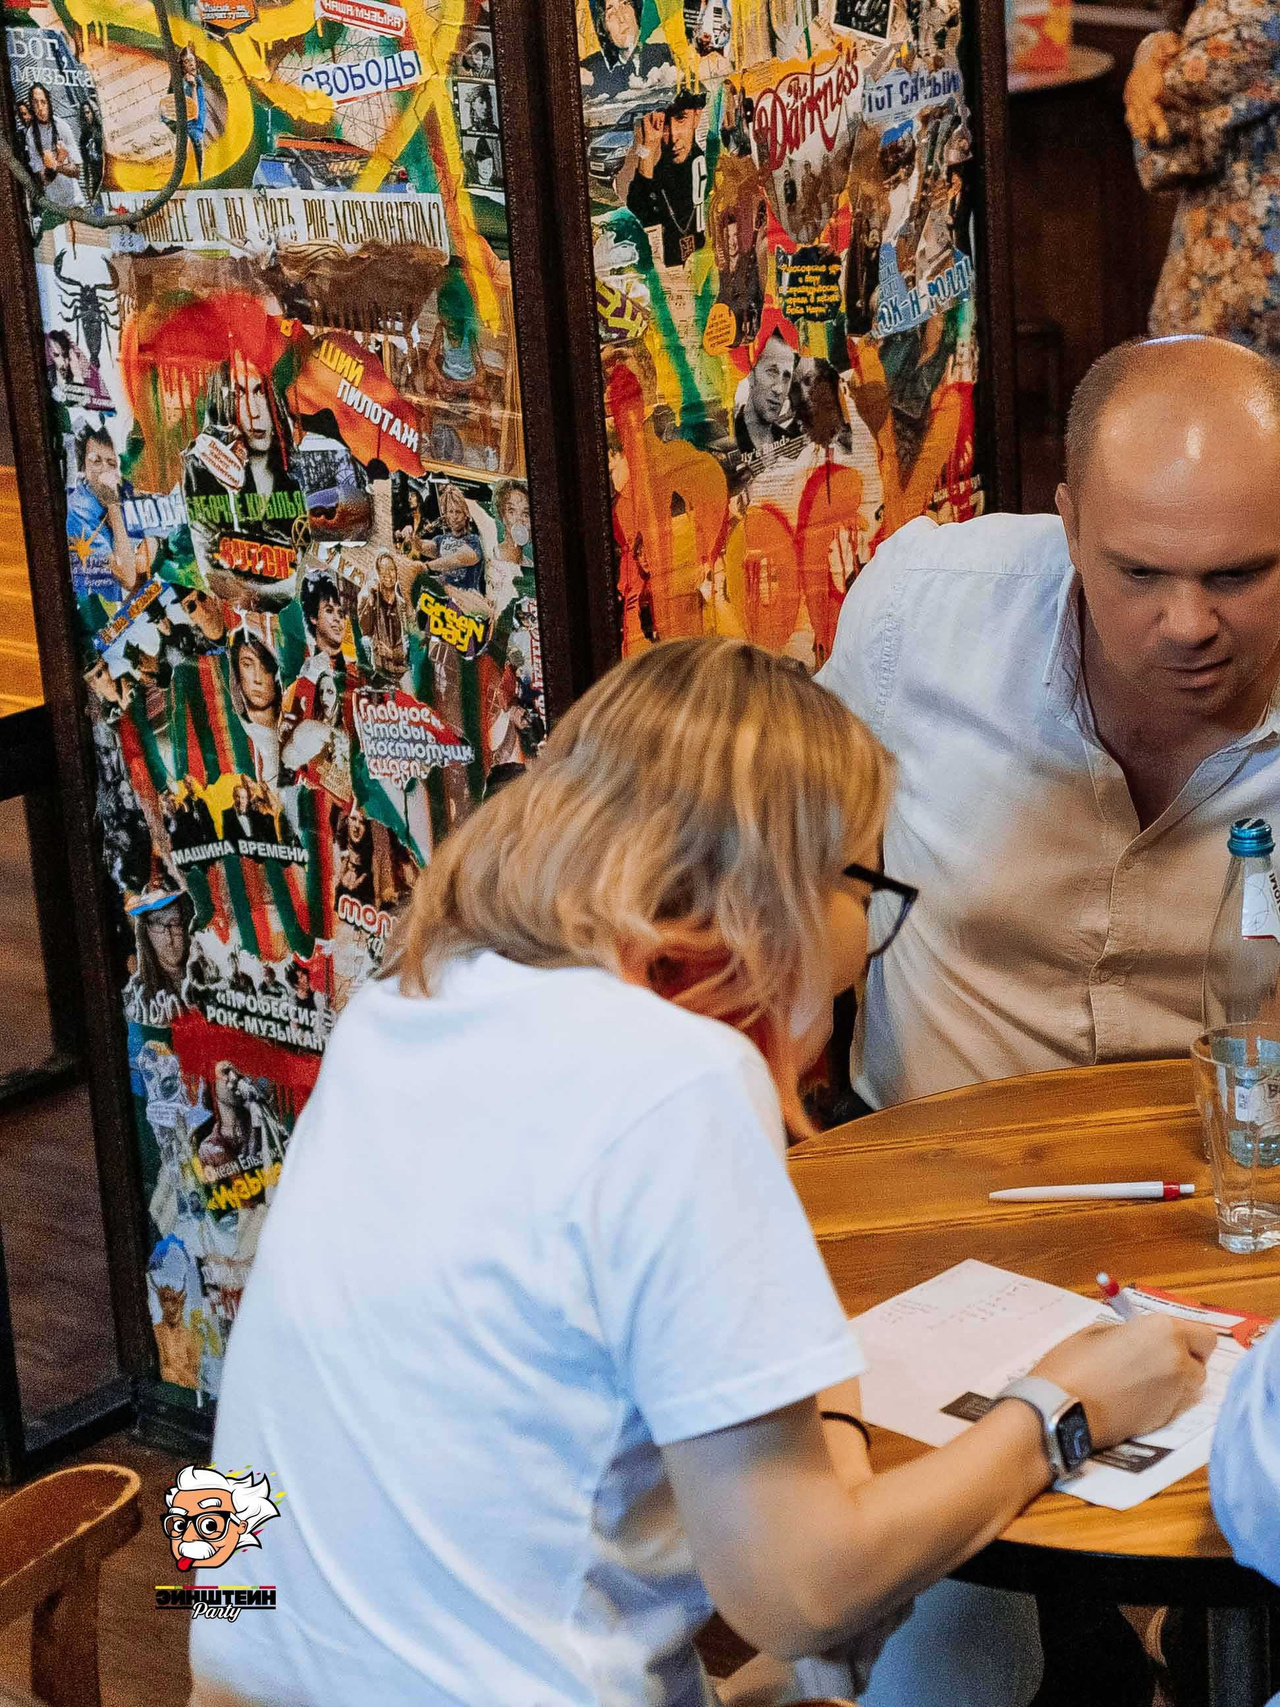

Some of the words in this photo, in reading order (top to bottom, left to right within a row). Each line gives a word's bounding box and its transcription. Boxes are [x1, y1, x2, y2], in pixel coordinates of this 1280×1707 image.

[354, 7, 401, 28] МУЗЫКА
[313, 340, 365, 388] ШИЙ
[337, 378, 419, 453] ПИЛОТАЖ
[170, 840, 235, 865] МАШИНА
[238, 840, 309, 861] ВРЕМЕНИ
